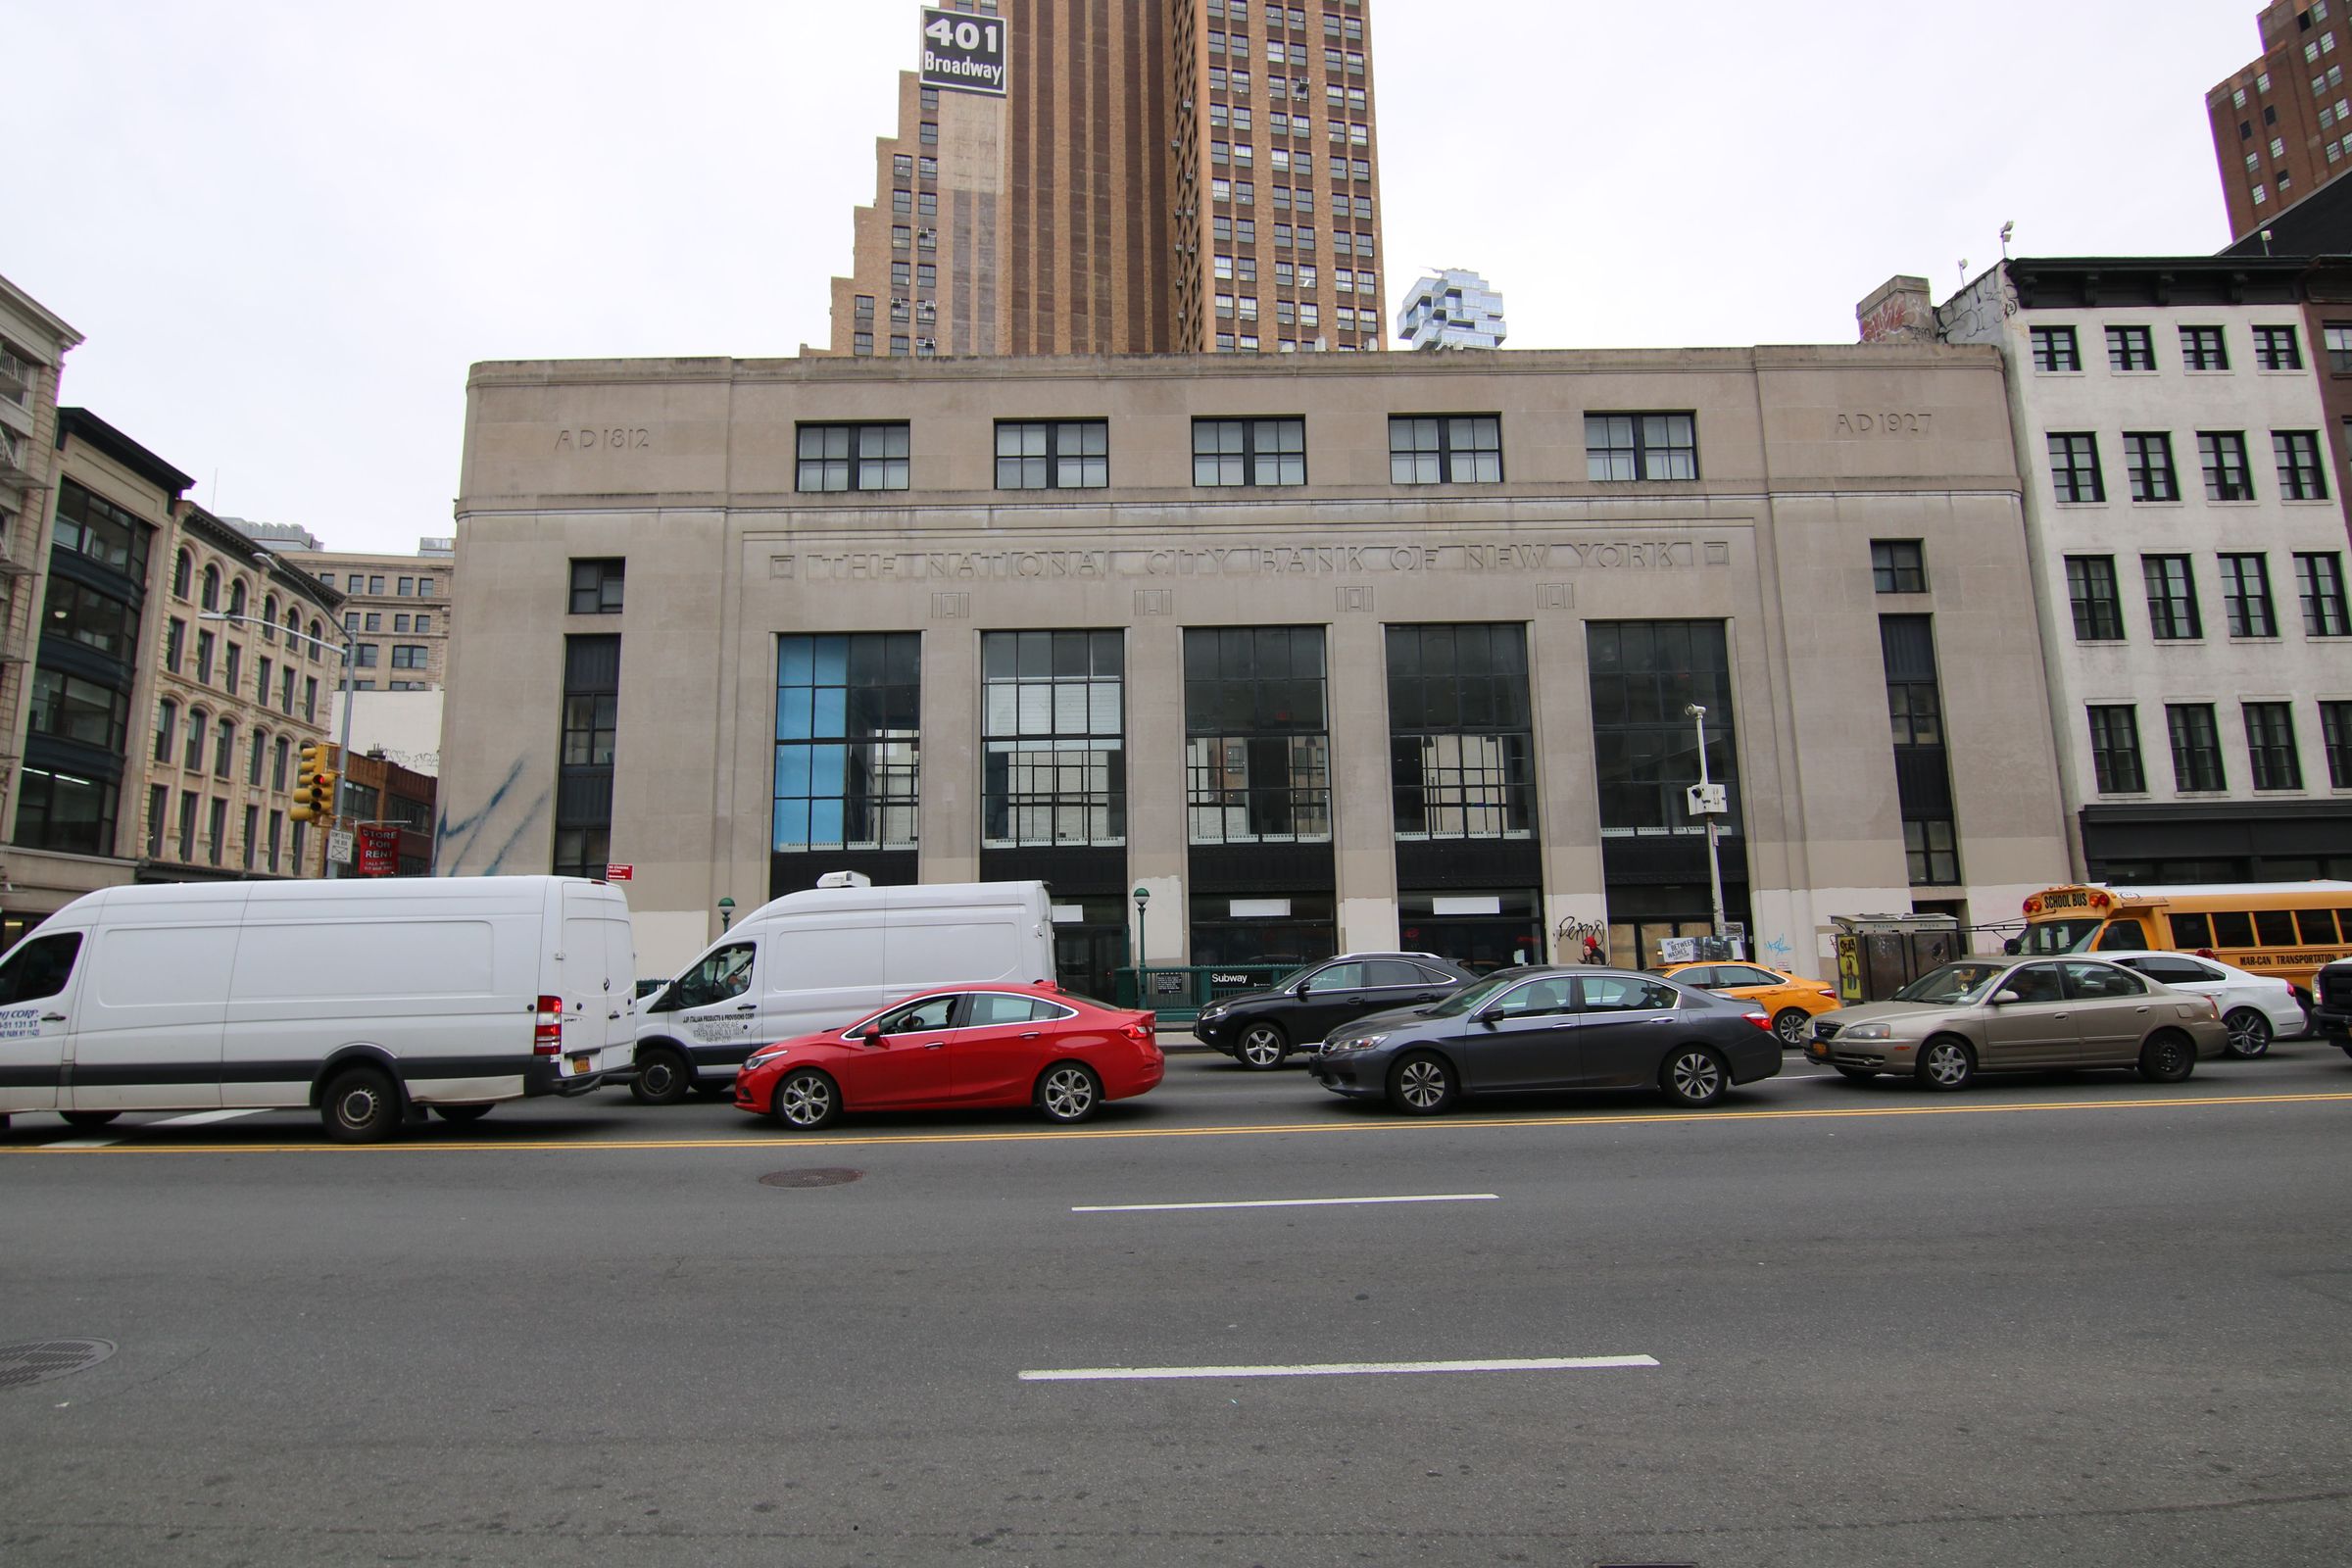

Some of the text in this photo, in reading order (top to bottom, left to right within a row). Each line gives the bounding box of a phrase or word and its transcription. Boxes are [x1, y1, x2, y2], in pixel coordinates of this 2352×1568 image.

[925, 18, 997, 53] 401
[924, 50, 1003, 85] Broadway
[1879, 413, 1932, 433] 1927
[603, 428, 649, 450] 1812
[821, 542, 1675, 580] THE NATIONAL CITY BANK OF NEW YORK
[363, 829, 398, 840] STORE
[369, 840, 391, 849] FOR
[365, 850, 392, 858] RENT
[2044, 893, 2087, 909] SCHOOL BUS
[1671, 939, 1694, 951] BETWEEN
[2239, 956, 2272, 965] MAR-CAN
[2276, 954, 2337, 965] TRANSPORTATION
[1211, 973, 1248, 984] Subway
